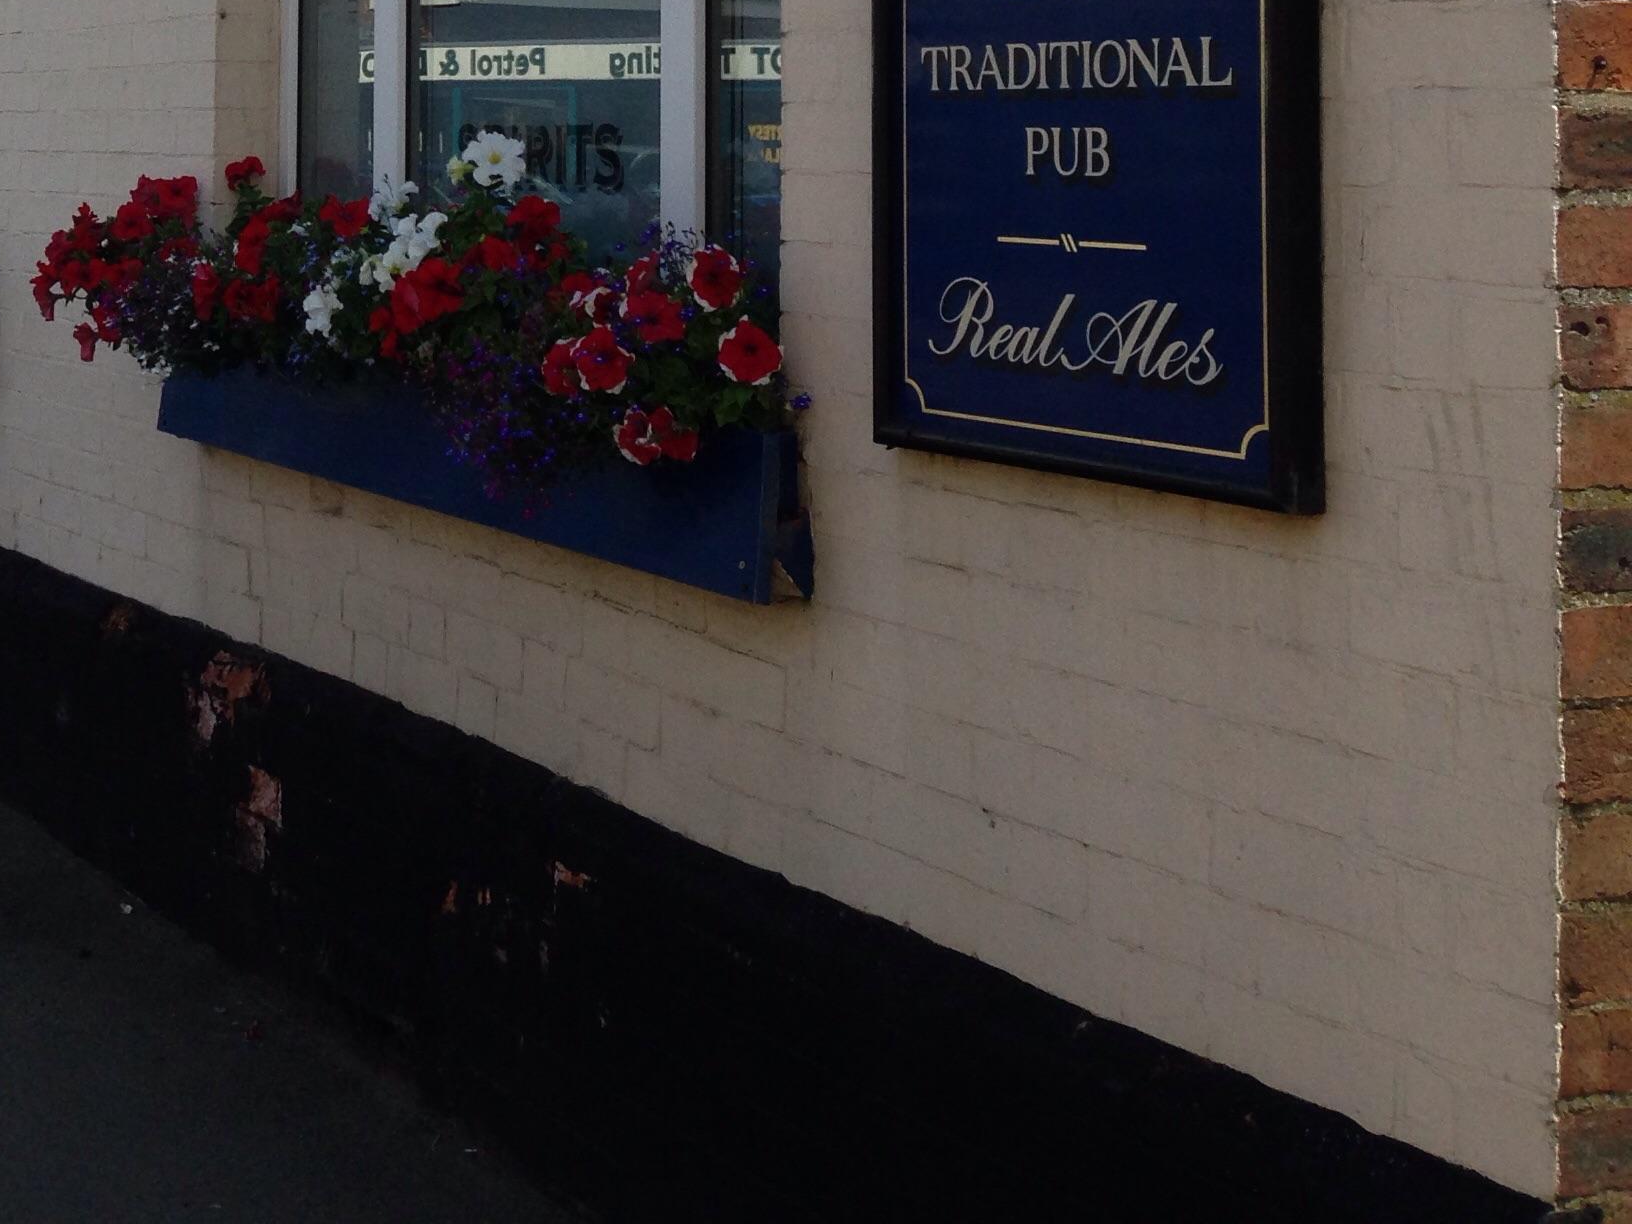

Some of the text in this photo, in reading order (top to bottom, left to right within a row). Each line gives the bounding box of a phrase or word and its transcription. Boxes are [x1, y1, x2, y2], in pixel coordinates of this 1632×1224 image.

[921, 36, 1233, 91] TRADITIONAL
[459, 123, 625, 192] RITS
[1024, 127, 1111, 177] PUB
[928, 277, 1224, 386] Real Ales
